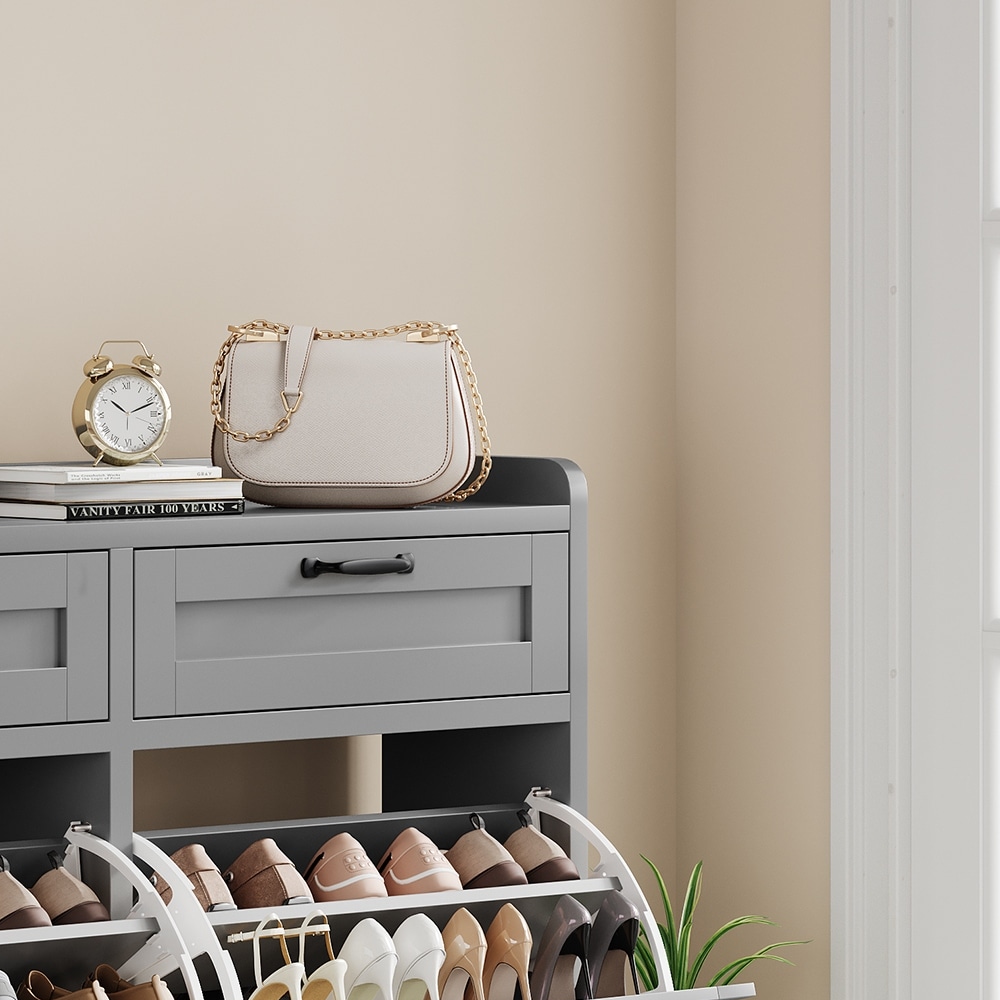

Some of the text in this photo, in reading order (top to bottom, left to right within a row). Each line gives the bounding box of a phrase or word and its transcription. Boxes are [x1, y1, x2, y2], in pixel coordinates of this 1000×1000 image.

[69, 505, 121, 517] VANITY
[125, 504, 156, 515] FAIR
[160, 503, 179, 514] 100
[182, 502, 225, 513] YEARS
